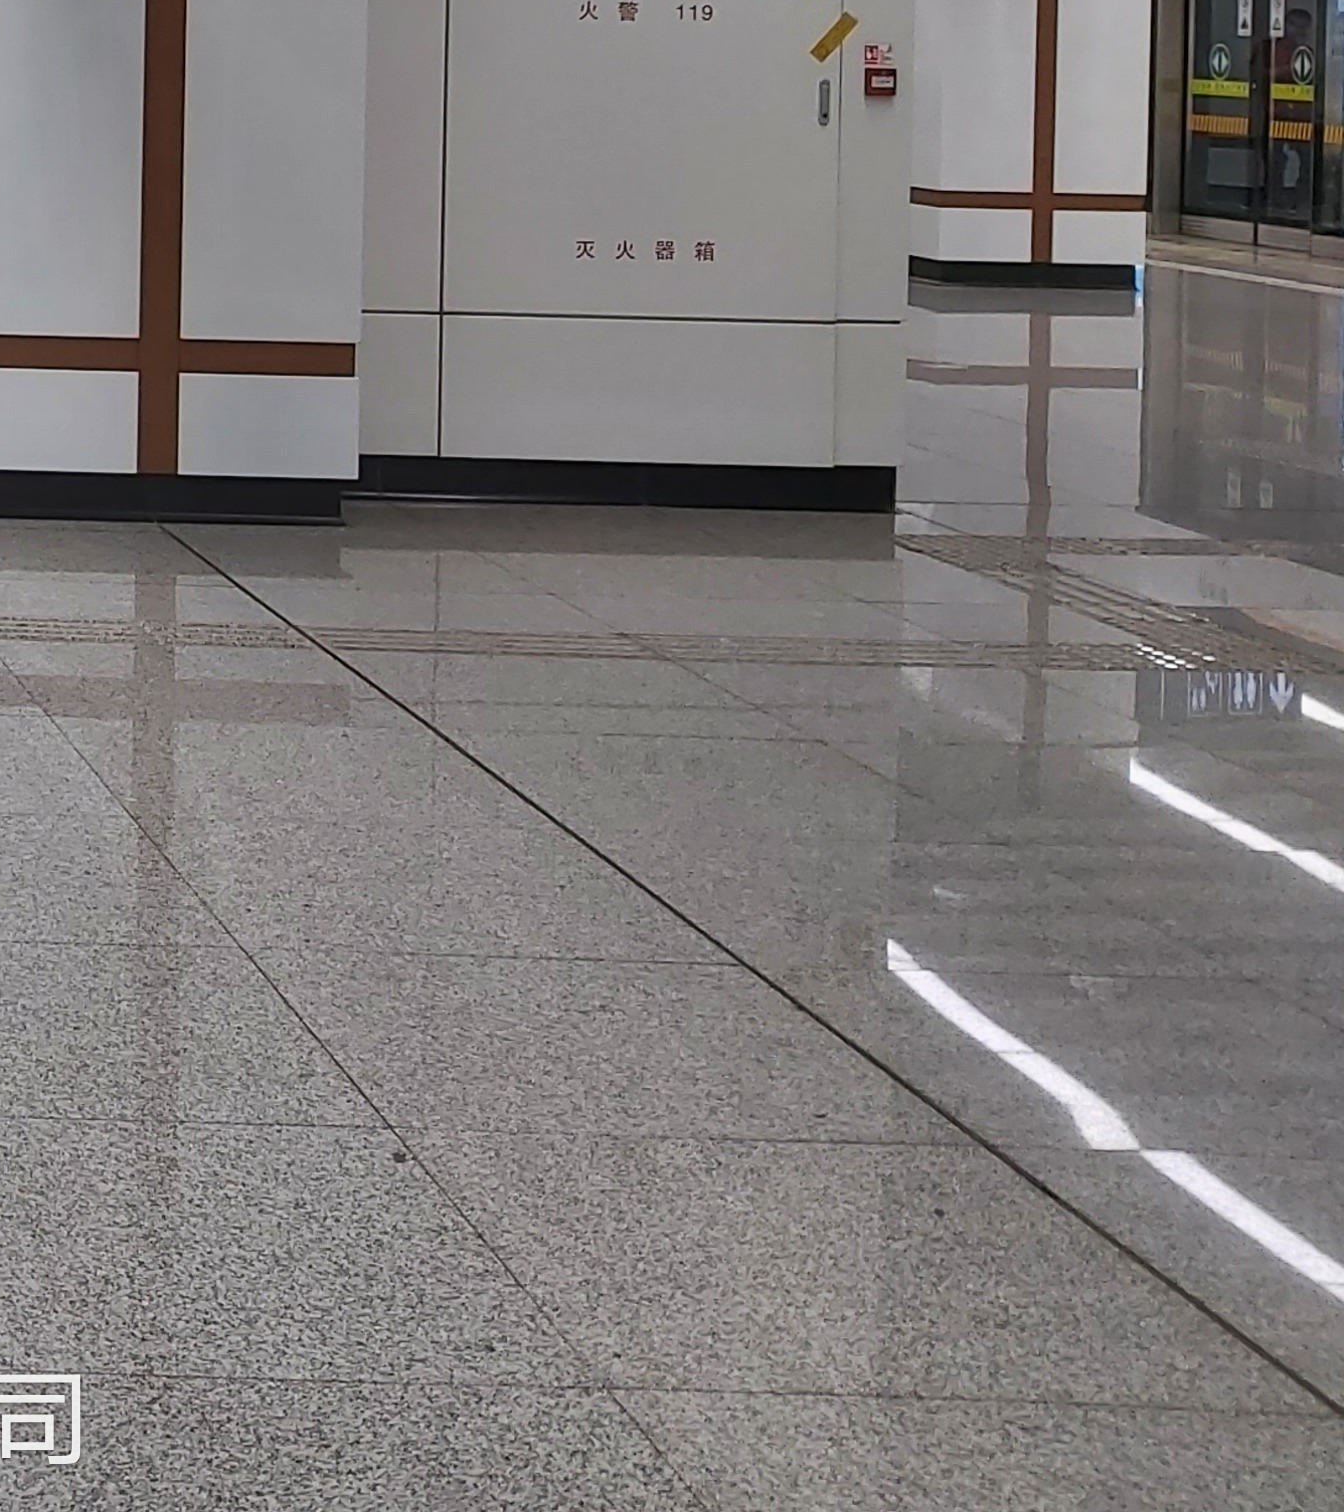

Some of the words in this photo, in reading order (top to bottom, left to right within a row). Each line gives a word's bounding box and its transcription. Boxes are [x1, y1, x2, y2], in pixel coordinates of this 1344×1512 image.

[579, 0, 640, 22] 火警
[676, 4, 714, 22] 119
[575, 240, 716, 263] 灭火器箱
